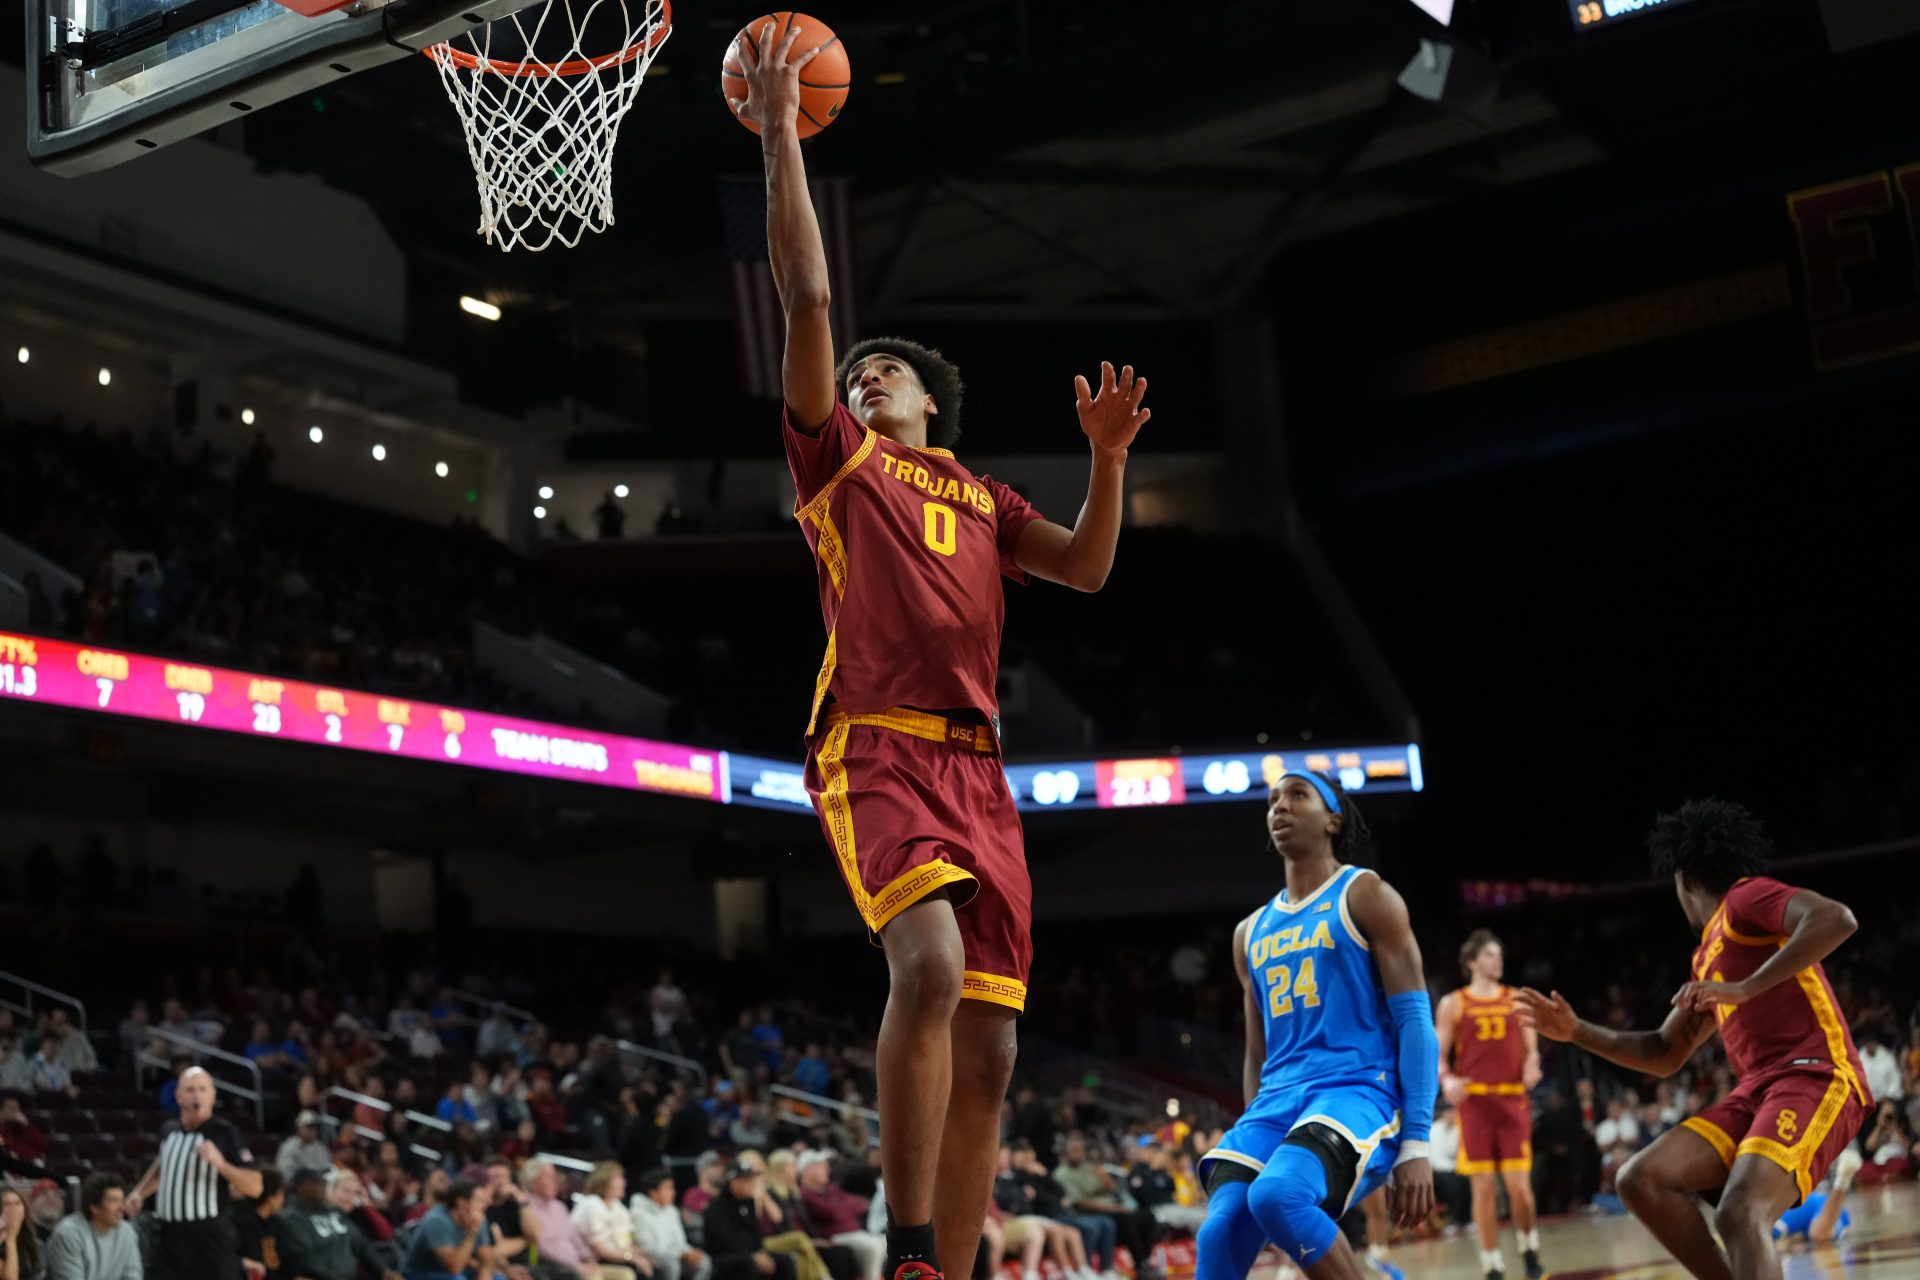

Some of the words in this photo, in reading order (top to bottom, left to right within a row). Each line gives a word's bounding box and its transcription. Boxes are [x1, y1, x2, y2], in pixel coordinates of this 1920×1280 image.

[881, 452, 993, 515] TROJANS
[923, 501, 956, 556] 0
[96, 677, 114, 708] 7
[176, 691, 205, 722] 19
[324, 714, 342, 743] 2
[951, 726, 974, 742] USC
[444, 731, 462, 759] 6
[1250, 919, 1335, 970] UCLA
[1266, 956, 1321, 1019] 24
[1475, 1017, 1506, 1041] 33
